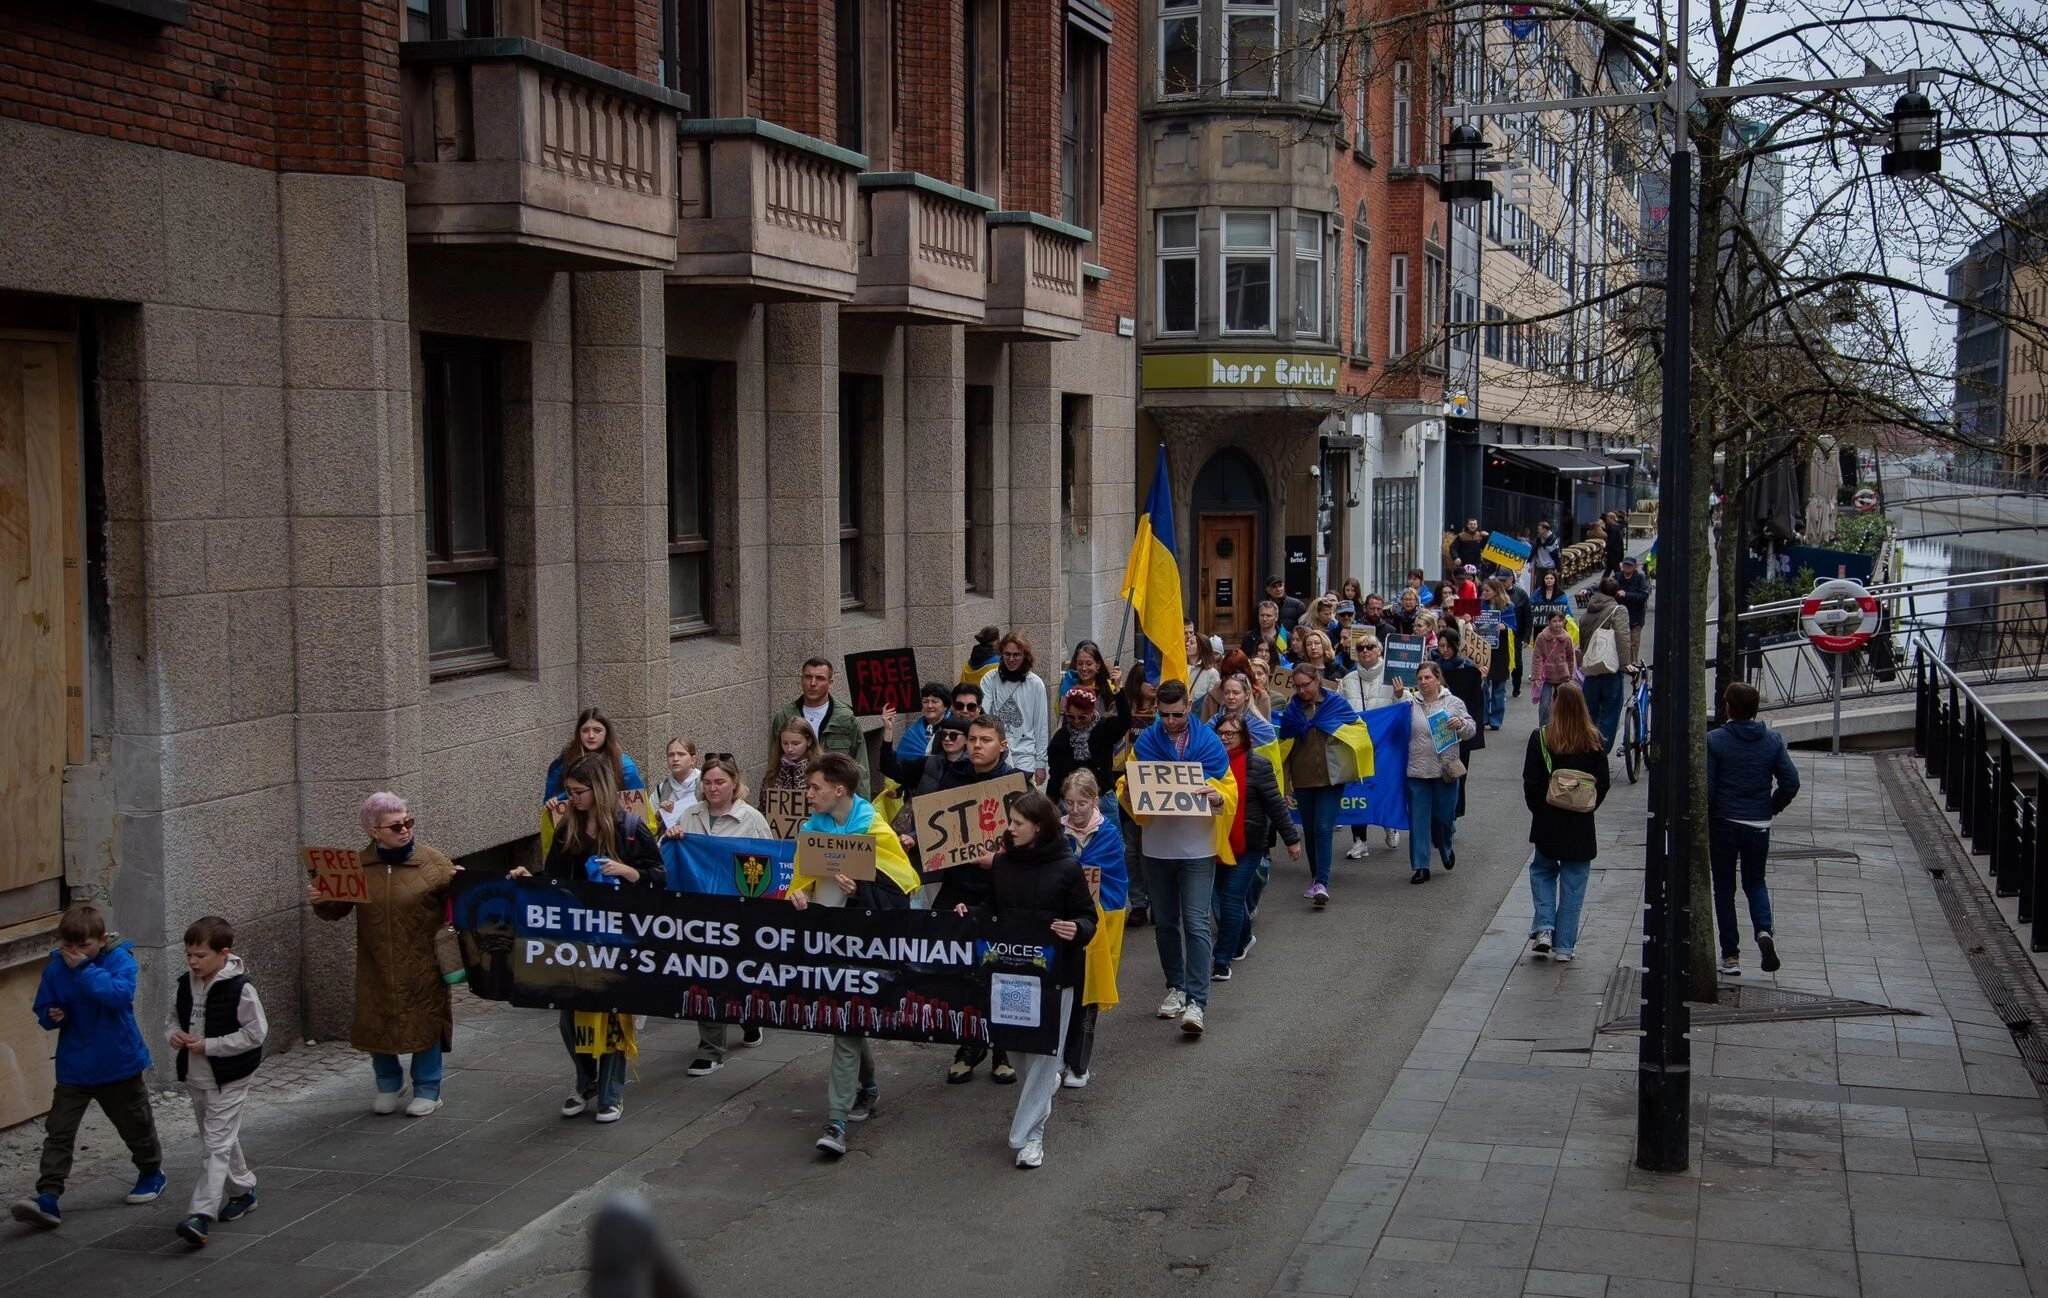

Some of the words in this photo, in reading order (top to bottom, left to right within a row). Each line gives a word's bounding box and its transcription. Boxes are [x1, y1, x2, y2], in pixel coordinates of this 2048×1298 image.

[1212, 358, 1267, 384] herr
[1532, 616, 1549, 625] KIL
[1464, 628, 1488, 655] FREE
[1461, 646, 1489, 667] AZOV
[855, 656, 912, 685] FREE
[857, 684, 912, 713] AZOV
[1137, 765, 1204, 786] FREE
[768, 790, 813, 817] FREE
[1137, 791, 1207, 812] AZOV
[808, 837, 872, 853] OLENIVKA
[309, 849, 359, 870] FREE
[318, 873, 368, 899] AZOV
[780, 872, 794, 880] TA
[527, 904, 561, 930] BE
[568, 908, 623, 935] THE
[630, 913, 740, 947] VOICES
[754, 926, 796, 952] OF
[804, 931, 973, 965] UKRAINIAN
[986, 941, 1044, 957] VOICES
[526, 941, 655, 973] P.O.W.’S
[662, 953, 729, 979] AND
[736, 960, 880, 996] CAPTIVES
